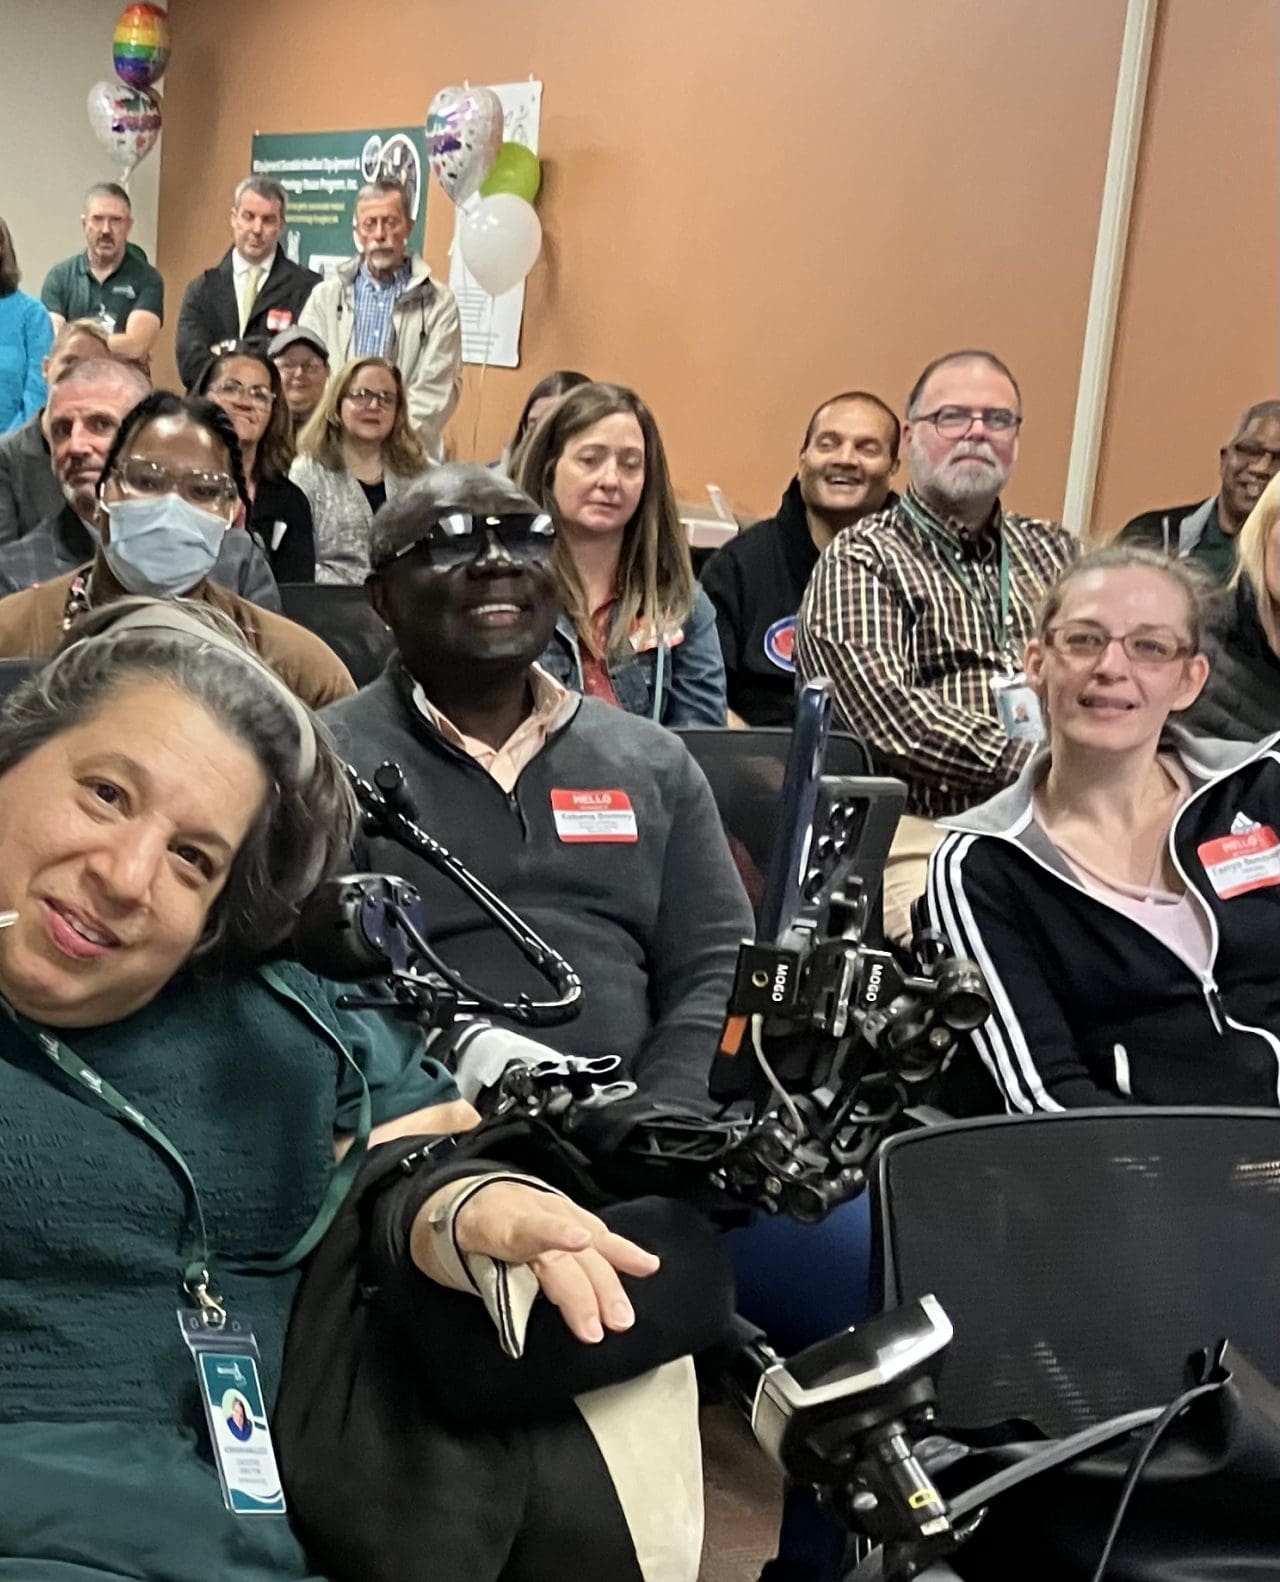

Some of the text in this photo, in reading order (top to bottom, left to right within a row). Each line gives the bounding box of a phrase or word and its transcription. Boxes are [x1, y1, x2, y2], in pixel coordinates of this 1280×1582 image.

[572, 793, 612, 804] HELLO
[772, 964, 789, 1002] MOGO
[866, 964, 884, 1002] MOGO
